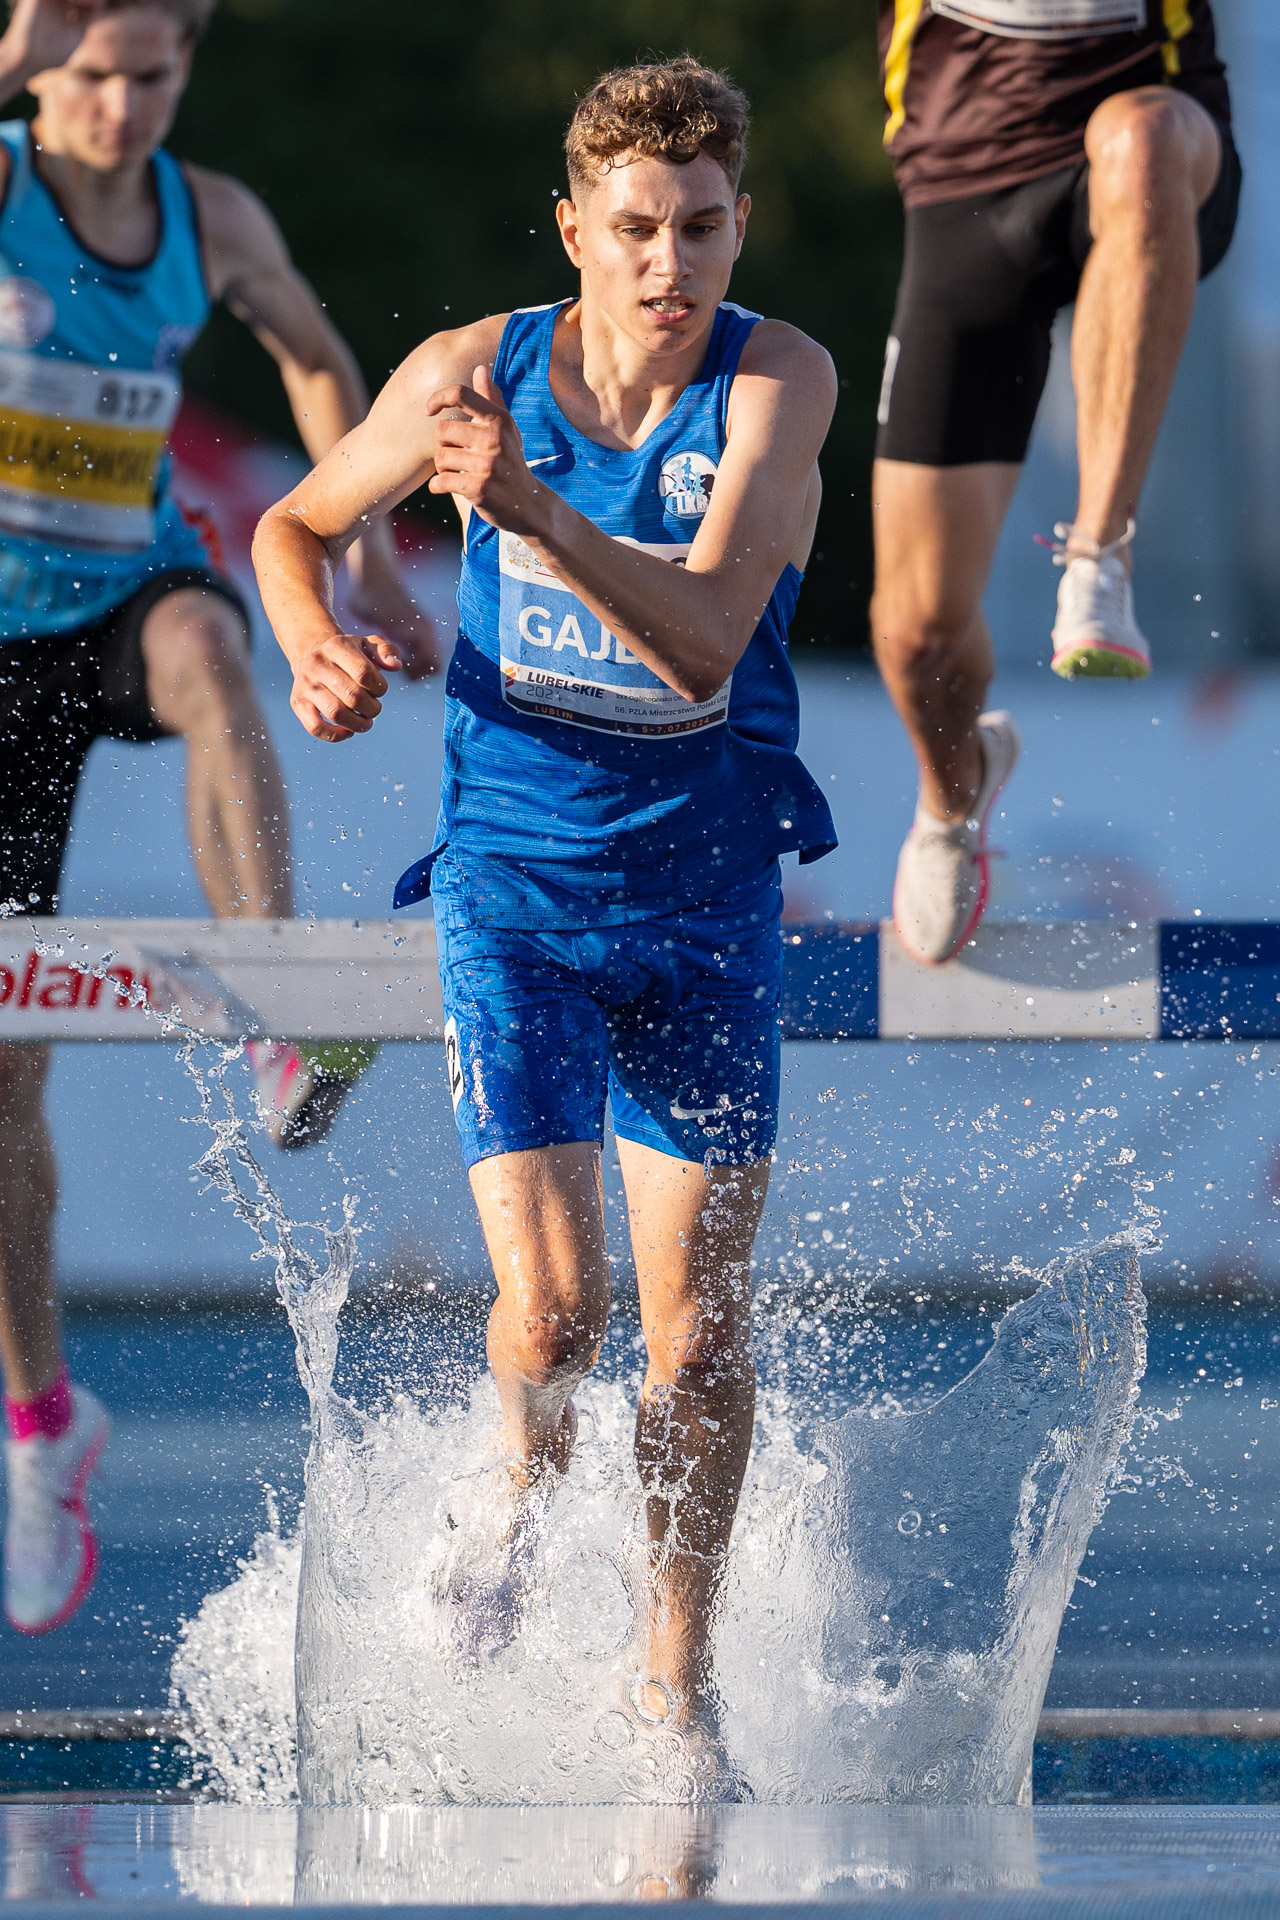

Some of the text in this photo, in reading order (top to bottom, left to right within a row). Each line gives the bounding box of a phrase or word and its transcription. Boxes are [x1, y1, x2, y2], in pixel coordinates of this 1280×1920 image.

[526, 685, 562, 701] 2024
[527, 672, 605, 699] LUBELSKIE
[534, 705, 573, 720] LUBLIN
[628, 708, 648, 716] PZLA
[696, 700, 716, 711] Polski
[641, 716, 710, 734] 5-7.07.2024
